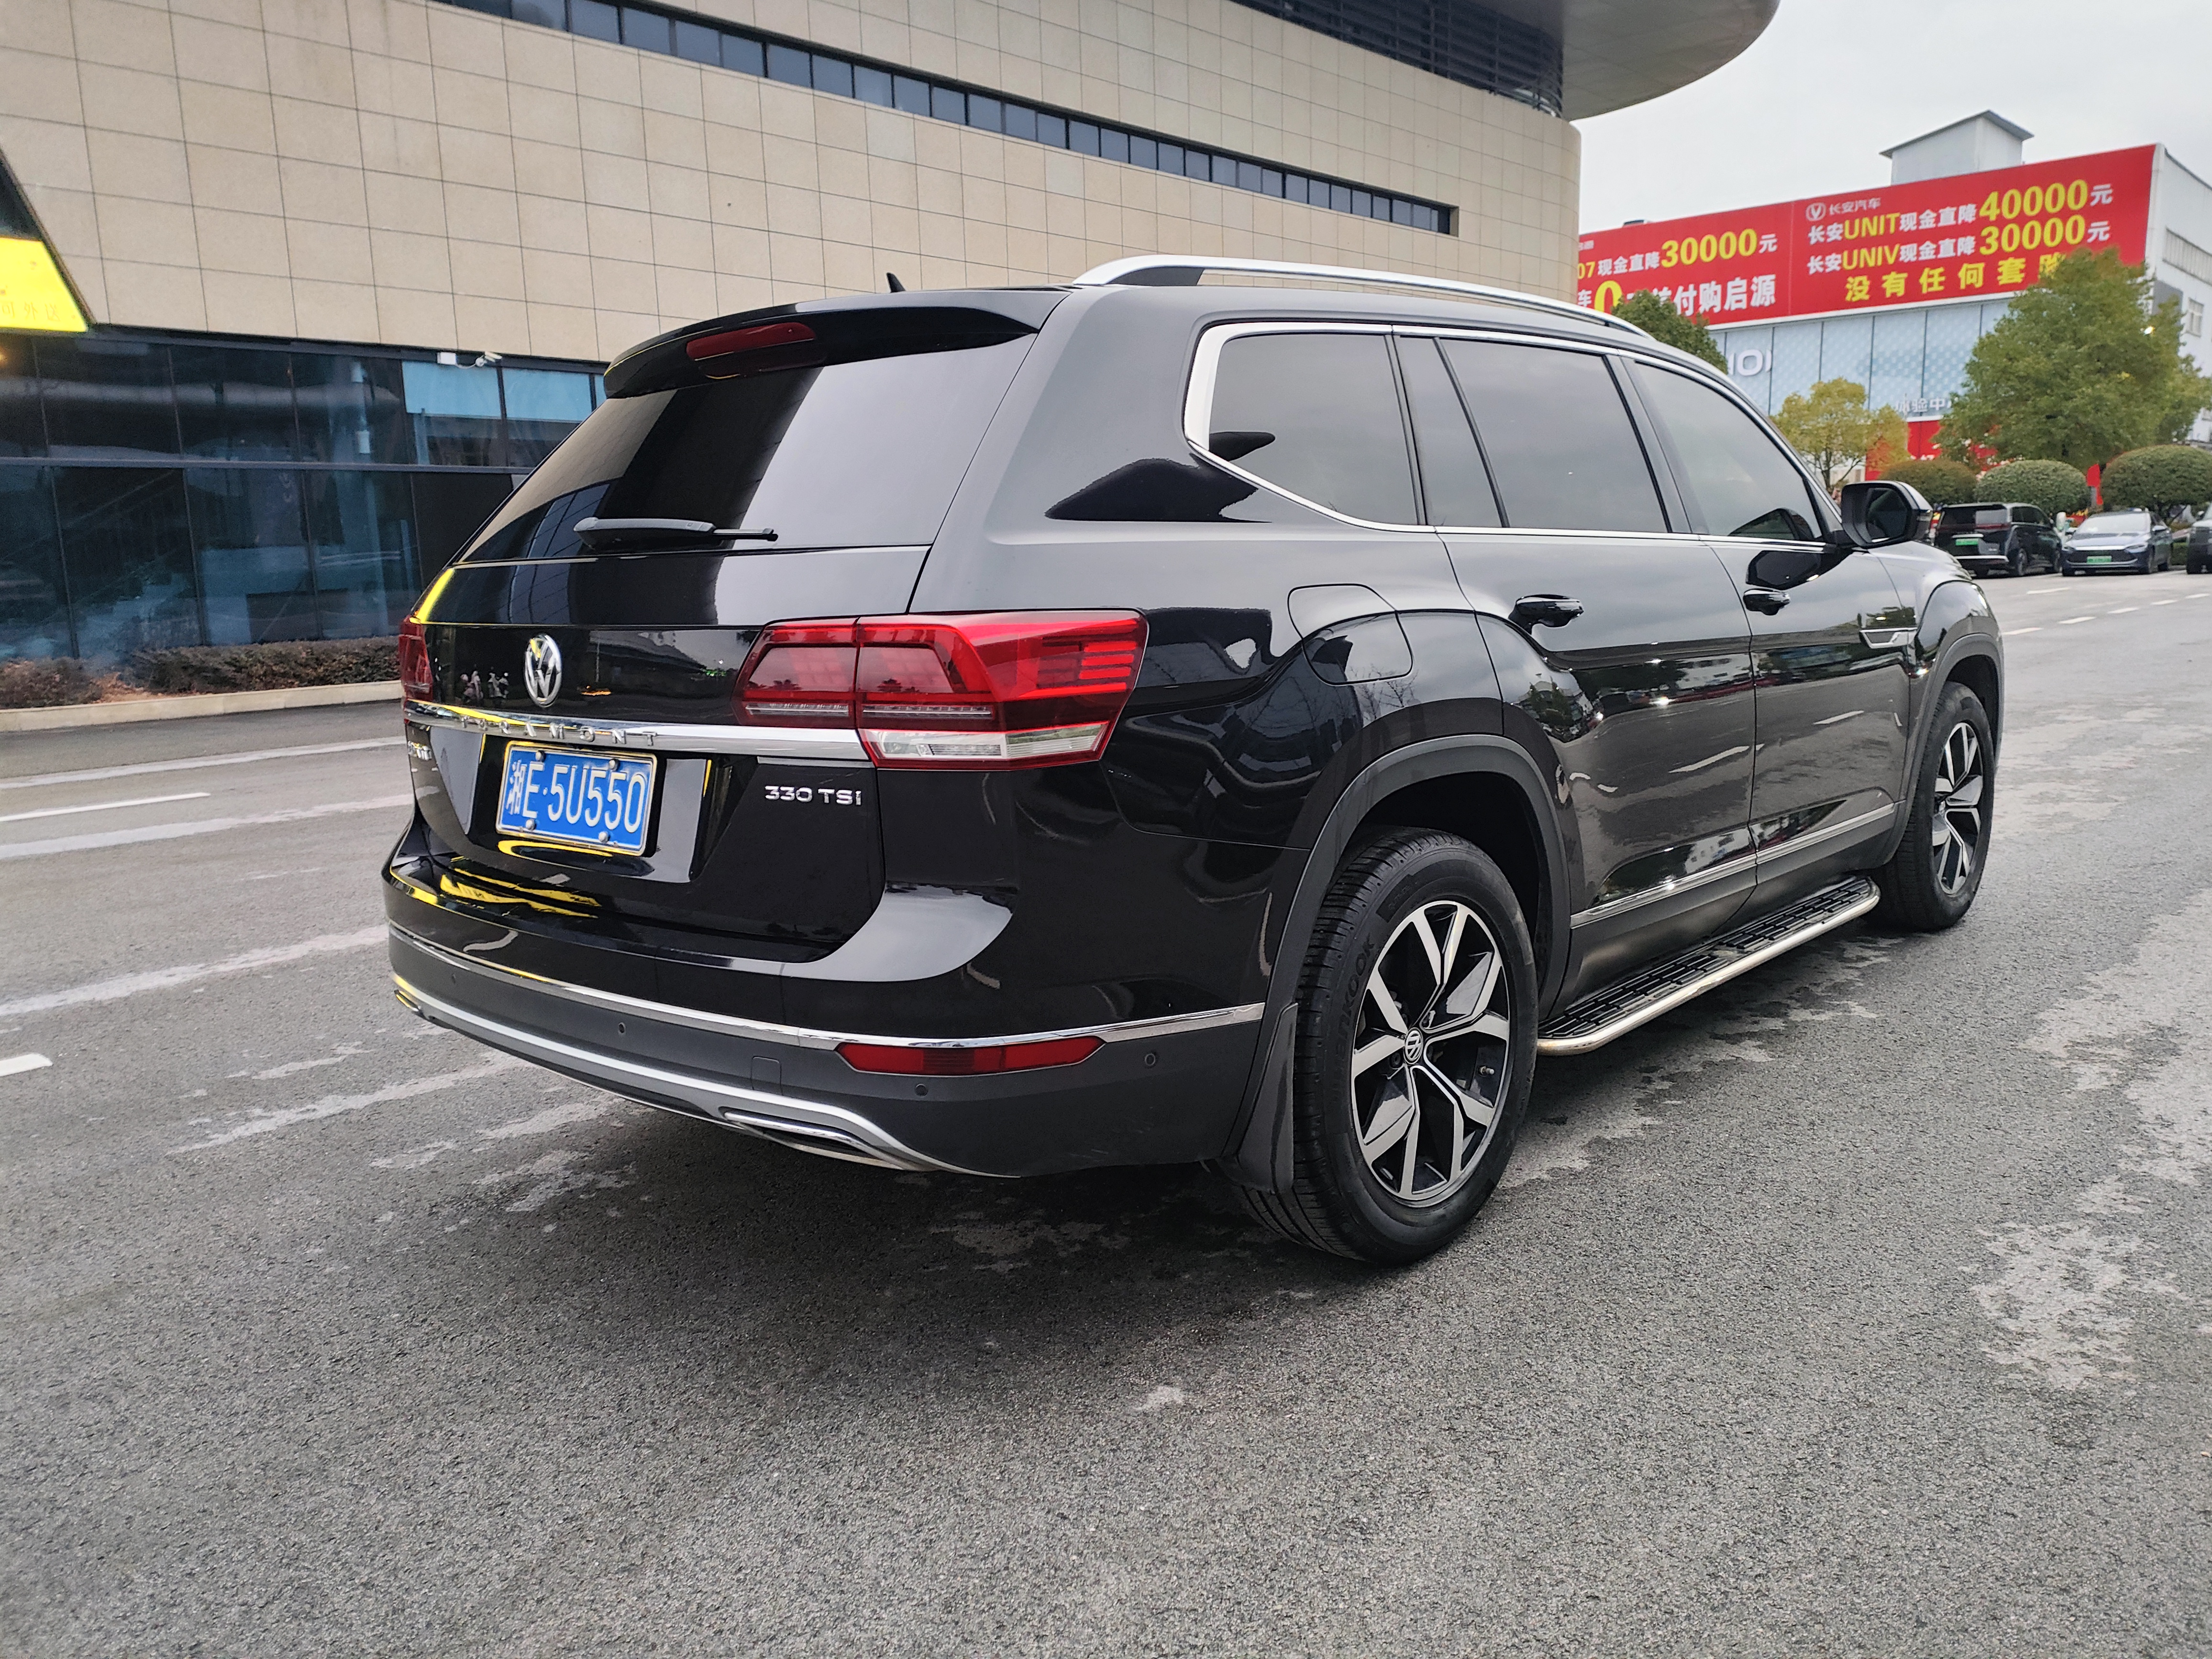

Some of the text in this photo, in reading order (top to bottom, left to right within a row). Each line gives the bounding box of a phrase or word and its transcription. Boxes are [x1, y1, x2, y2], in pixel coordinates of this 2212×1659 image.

[1829, 198, 1881, 215] 长安汽车
[765, 785, 812, 802] 330
